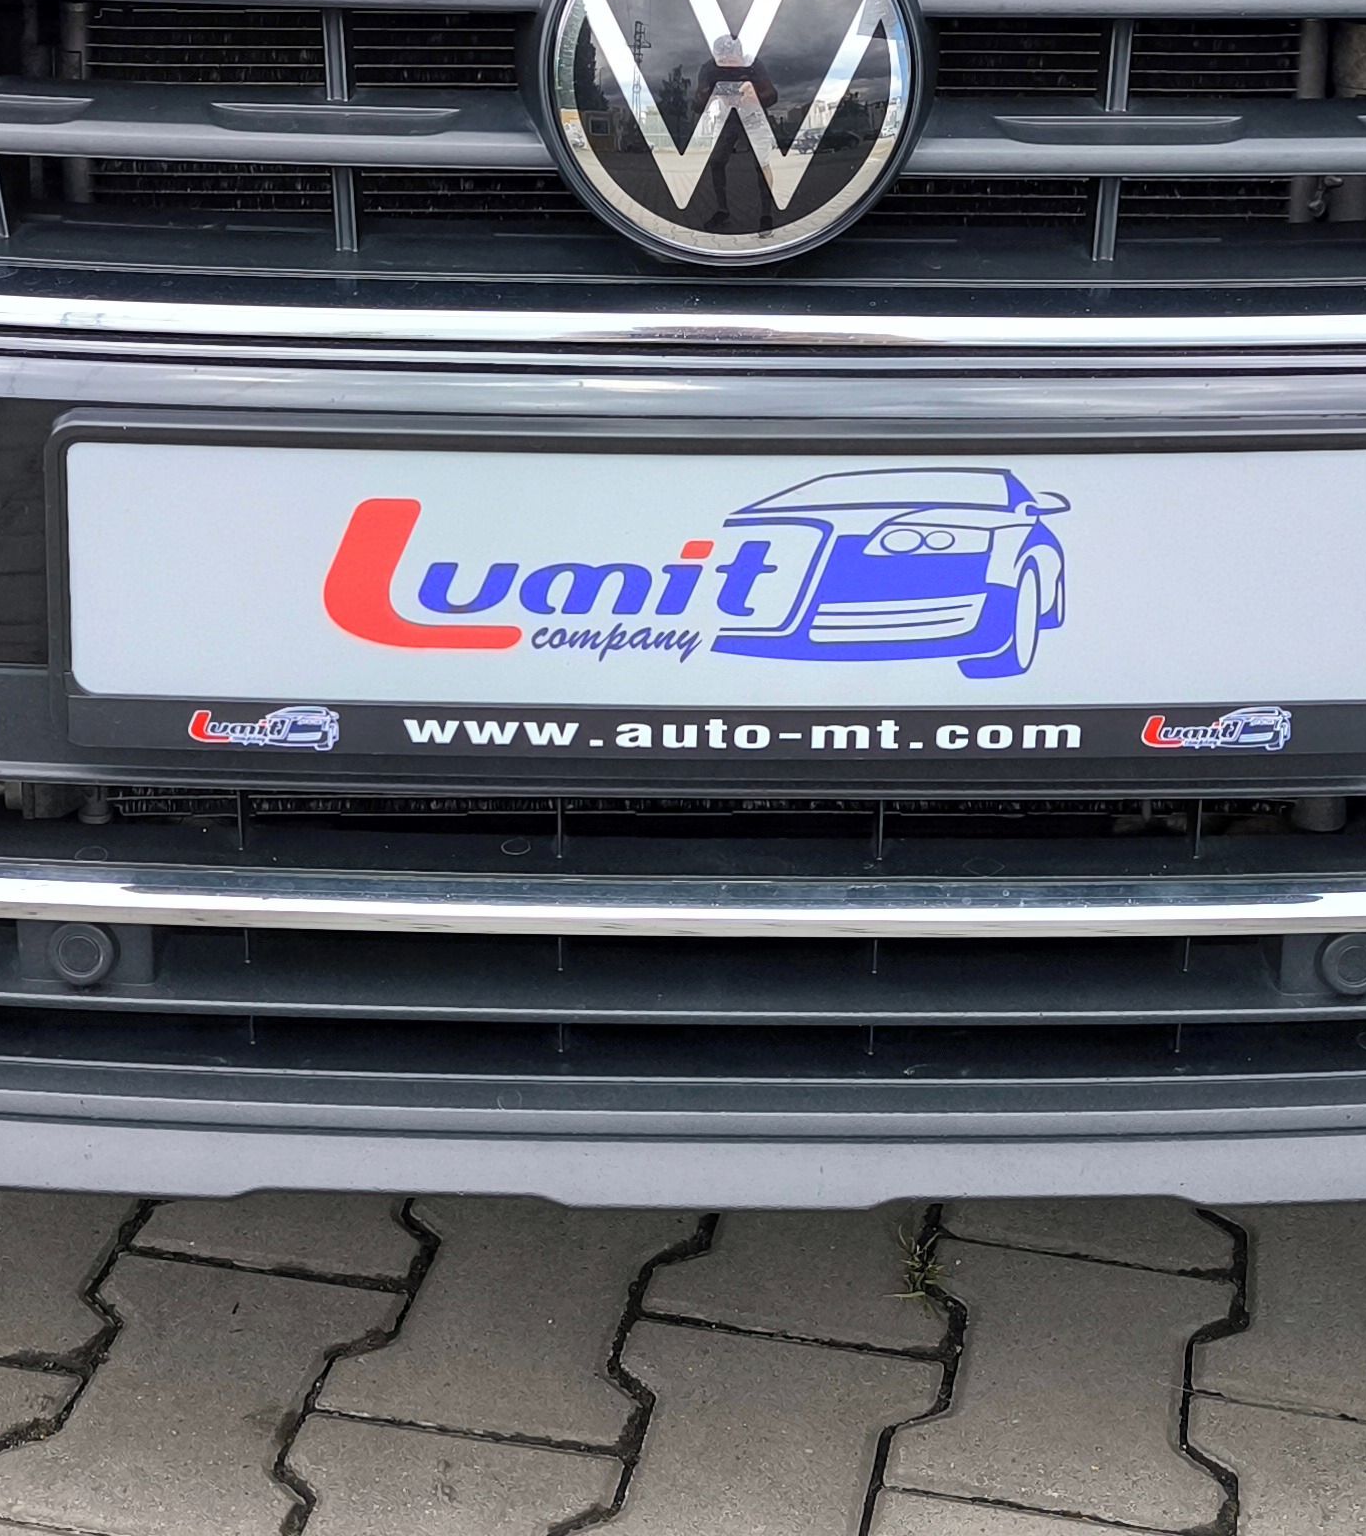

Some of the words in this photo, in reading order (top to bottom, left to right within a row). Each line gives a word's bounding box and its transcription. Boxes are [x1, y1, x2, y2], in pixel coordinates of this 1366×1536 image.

[323, 497, 778, 650] Lumit
[531, 622, 702, 663] company
[188, 710, 282, 743] Lumit
[402, 717, 1081, 750] www.auto-mt.com
[1141, 715, 1235, 748] Lumit
